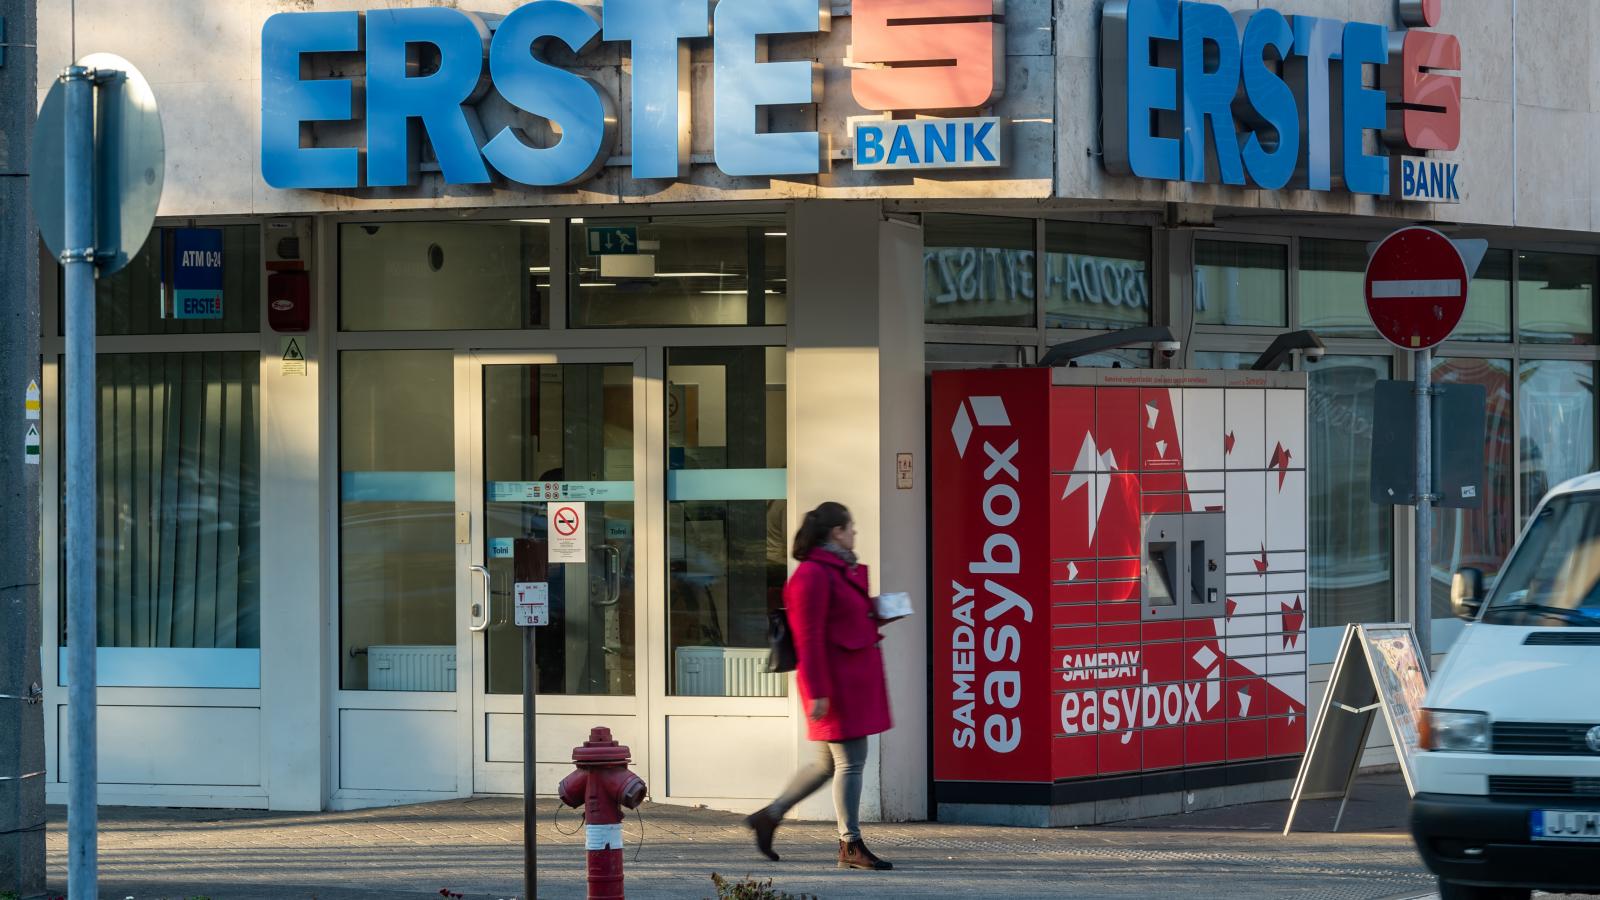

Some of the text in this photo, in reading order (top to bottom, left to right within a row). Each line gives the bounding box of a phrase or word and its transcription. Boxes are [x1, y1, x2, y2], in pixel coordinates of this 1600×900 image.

[261, 0, 821, 190] ERSTE
[1128, 0, 1390, 196] ERSTE
[855, 121, 998, 166] BANK
[1403, 160, 1460, 200] BANK
[182, 251, 221, 267] ATM 0-24
[184, 298, 215, 314] ERSTE
[492, 546, 509, 554] Tolni
[969, 439, 1033, 754] easybox
[952, 580, 975, 749] SAMEDAY
[1062, 651, 1139, 682] SAMEDAY
[1061, 669, 1202, 745] easybox
